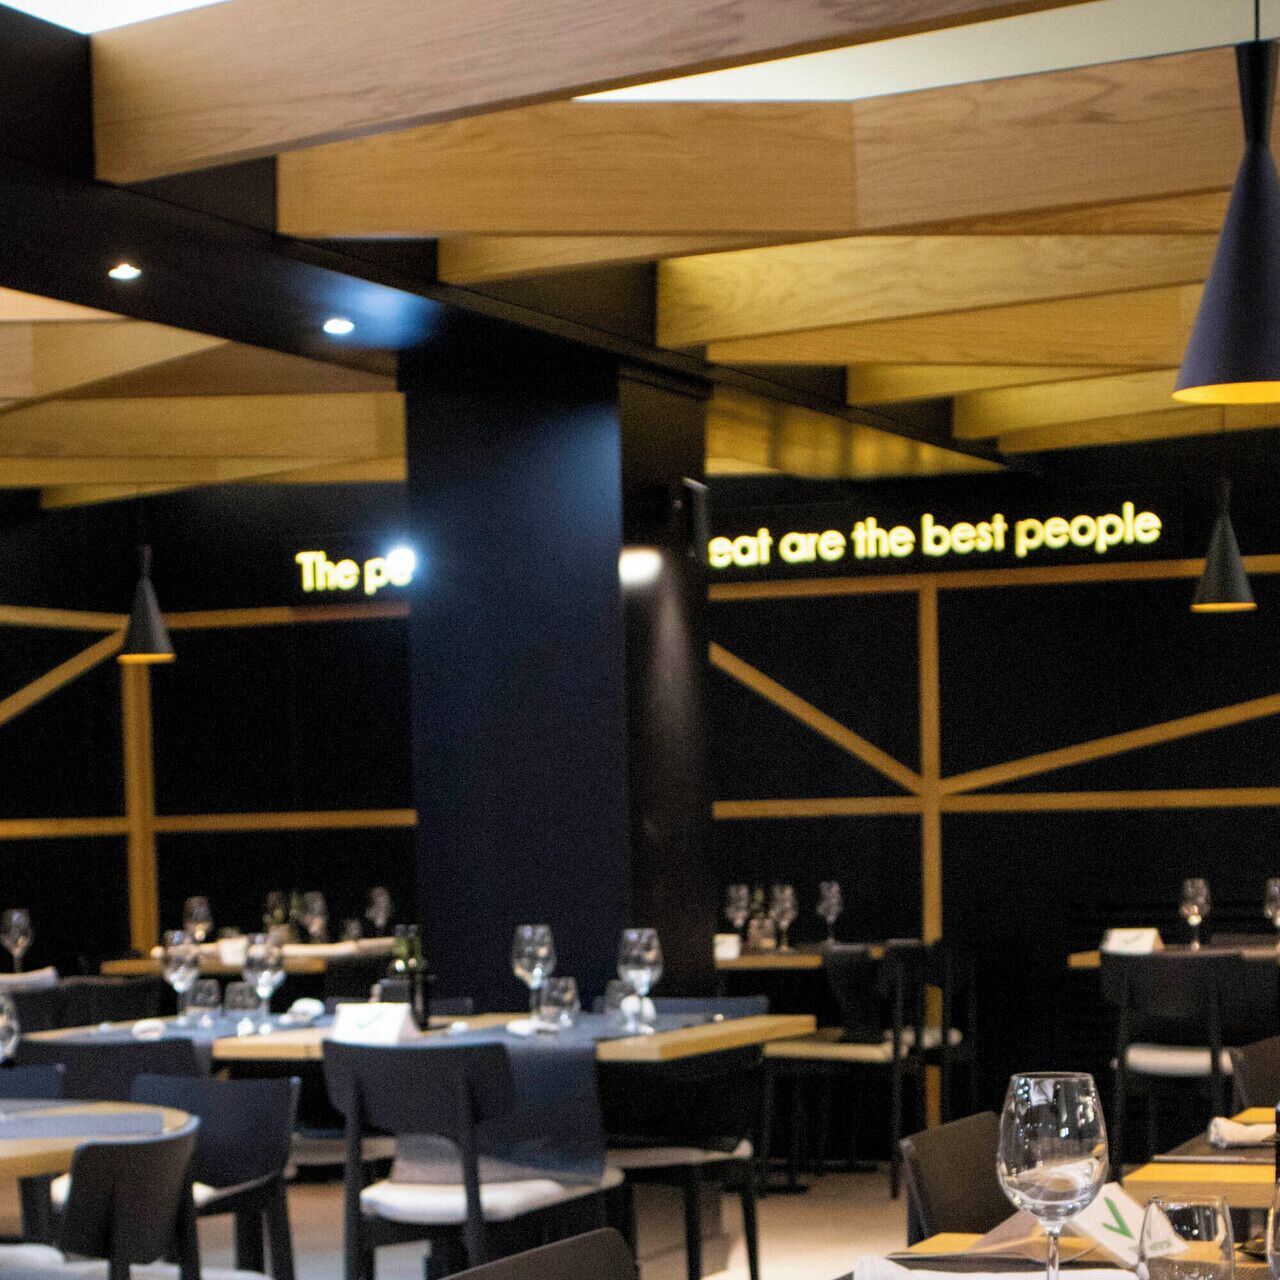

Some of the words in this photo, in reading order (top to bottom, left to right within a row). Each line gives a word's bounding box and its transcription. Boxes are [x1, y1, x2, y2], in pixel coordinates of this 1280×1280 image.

[295, 551, 360, 592] The
[707, 527, 772, 568] eat
[778, 529, 846, 563] are
[851, 516, 915, 559] the
[921, 513, 1008, 557] best
[1015, 501, 1162, 558] people
